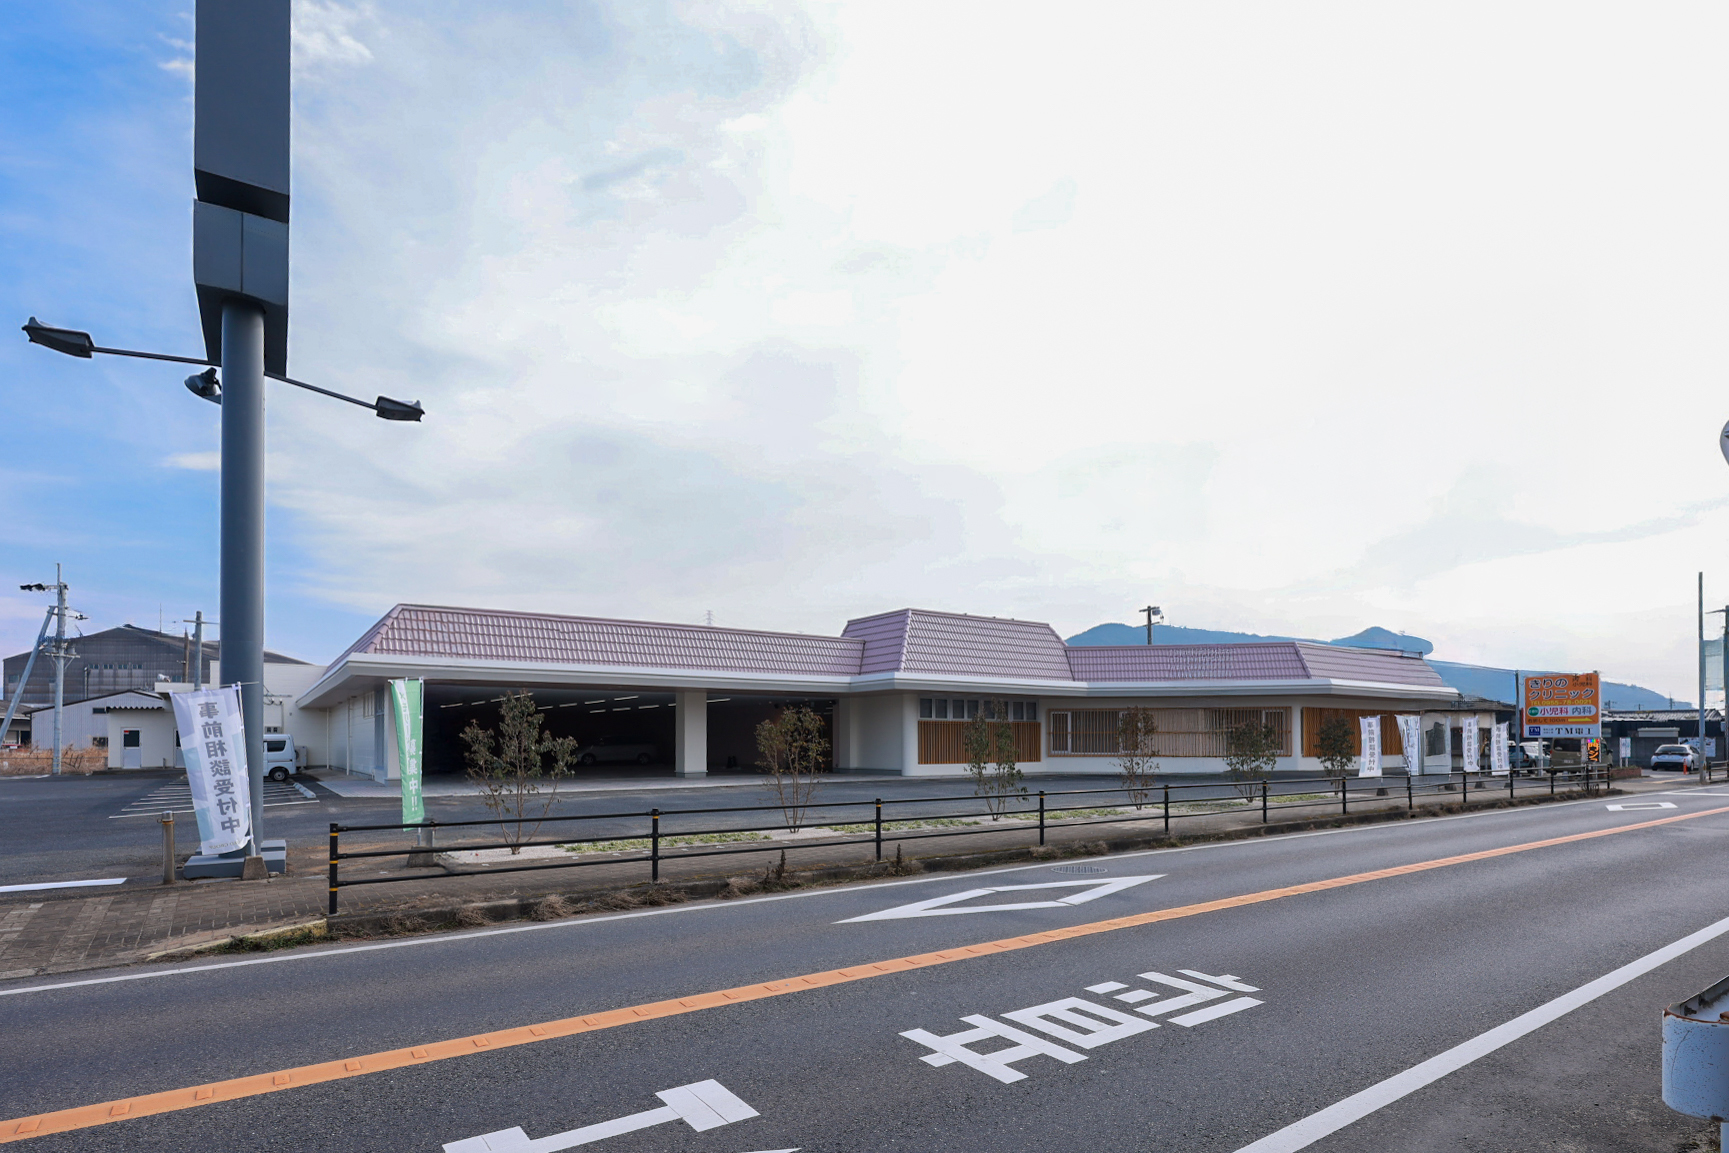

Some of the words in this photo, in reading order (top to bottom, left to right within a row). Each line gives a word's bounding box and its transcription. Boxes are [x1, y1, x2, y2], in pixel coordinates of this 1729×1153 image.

[1529, 677, 1568, 689] きりの
[1529, 688, 1595, 700] クリニック
[1540, 706, 1569, 716] 小児科
[1572, 706, 1592, 715] 内科
